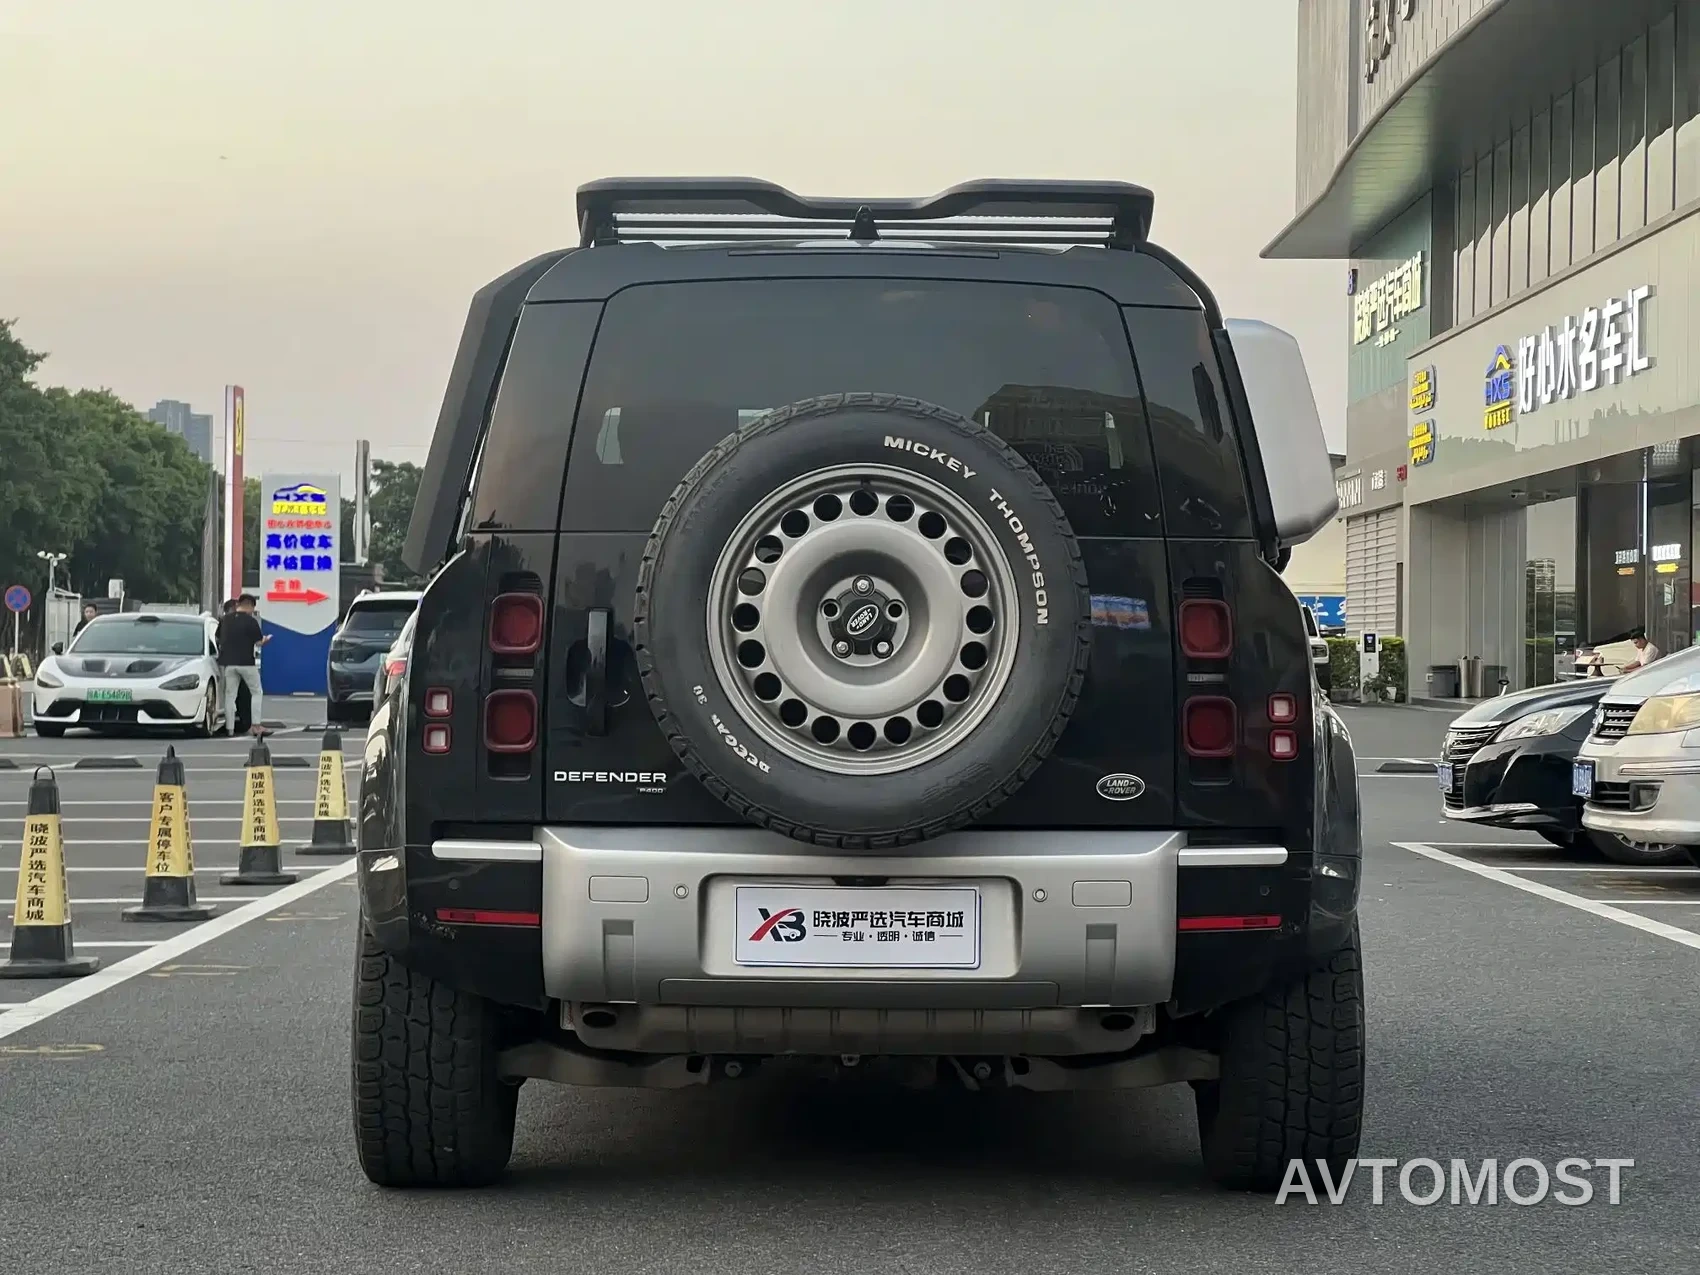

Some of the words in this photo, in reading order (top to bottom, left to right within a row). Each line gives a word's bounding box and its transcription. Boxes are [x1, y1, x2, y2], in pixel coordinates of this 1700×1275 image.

[1519, 285, 1650, 415] 好心水名车汇
[1485, 372, 1511, 406] HXS
[884, 436, 976, 479] MICKEY
[988, 488, 1049, 625] THOMPSON
[251, 772, 266, 842] 晓波严选汽车商城
[554, 771, 667, 783] DEFENDER
[155, 792, 174, 872] 客户专属停车位
[26, 823, 49, 920] 晓波严选汽车商城
[813, 910, 964, 928] 晓波严选汽车商城
